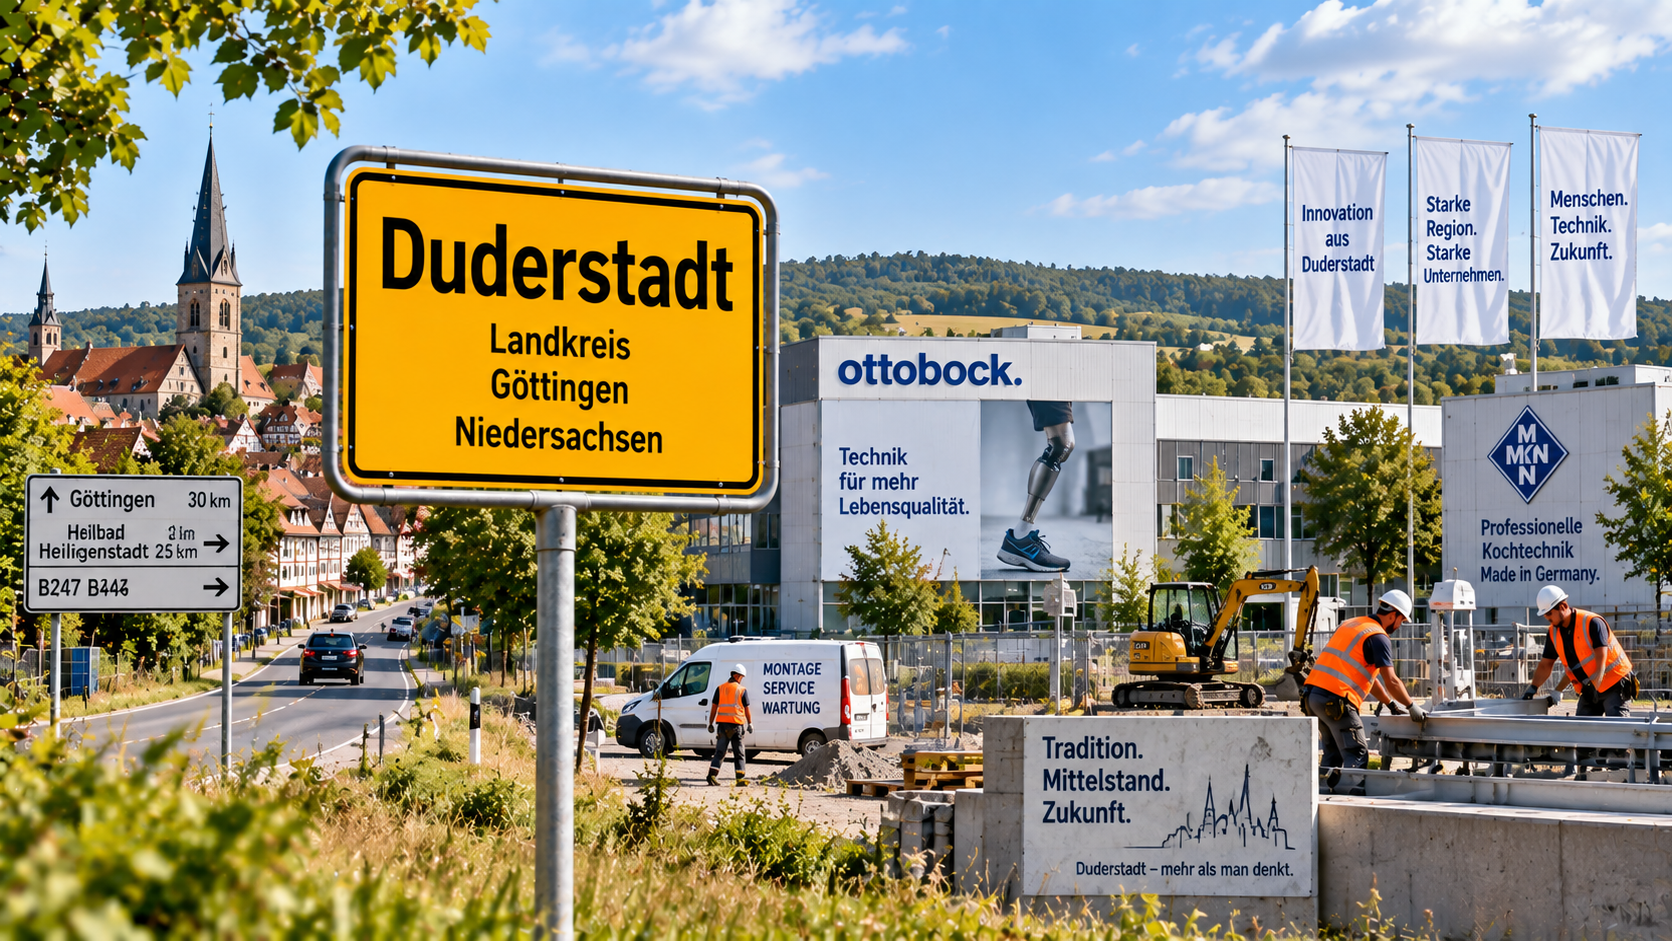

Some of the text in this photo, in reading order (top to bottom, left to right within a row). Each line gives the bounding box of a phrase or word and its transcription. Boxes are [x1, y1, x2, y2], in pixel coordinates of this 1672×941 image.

[1427, 195, 1470, 212] Starke
[1551, 189, 1627, 207] Menschen.
[1303, 203, 1372, 221] Innovation
[1427, 220, 1476, 240] Region.
[1551, 215, 1611, 234] Technik.
[1326, 234, 1349, 247] aus
[1427, 244, 1470, 260] Starke
[1551, 242, 1612, 260] Zukunft.
[383, 217, 733, 311] Duderstadt
[1303, 255, 1374, 272] Duderstadt
[1424, 267, 1504, 283] Unternehmen.
[491, 323, 630, 360] Landkreis
[838, 353, 1022, 386] ottobock.
[492, 368, 628, 410] Göttingen
[456, 416, 662, 453] Niedersachsen
[839, 447, 907, 465] Technik
[839, 472, 919, 490] für mehr
[71, 490, 230, 512] Göttingen 30 km
[840, 497, 969, 519] Lebensqualität.
[68, 524, 124, 540] Heilbad
[1482, 517, 1582, 535] Professionelle
[40, 543, 197, 562] Heiligenstadt 25 km
[1483, 541, 1574, 559] Kochtechnik
[1481, 566, 1599, 585] Made in Germany.
[39, 579, 81, 596] B247
[764, 663, 821, 675] MONTAGE
[764, 681, 815, 694] SERVICE
[762, 701, 820, 714] WARTUNG
[1042, 736, 1143, 759] Tradition.
[1044, 768, 1170, 791] Mittelstand.
[1043, 800, 1130, 823] Zukunft.
[1077, 862, 1146, 875] Duderstadt
[1161, 862, 1195, 875] mehr
[1198, 862, 1216, 876] als
[1221, 865, 1248, 876] man
[1253, 862, 1293, 876] denkt.
